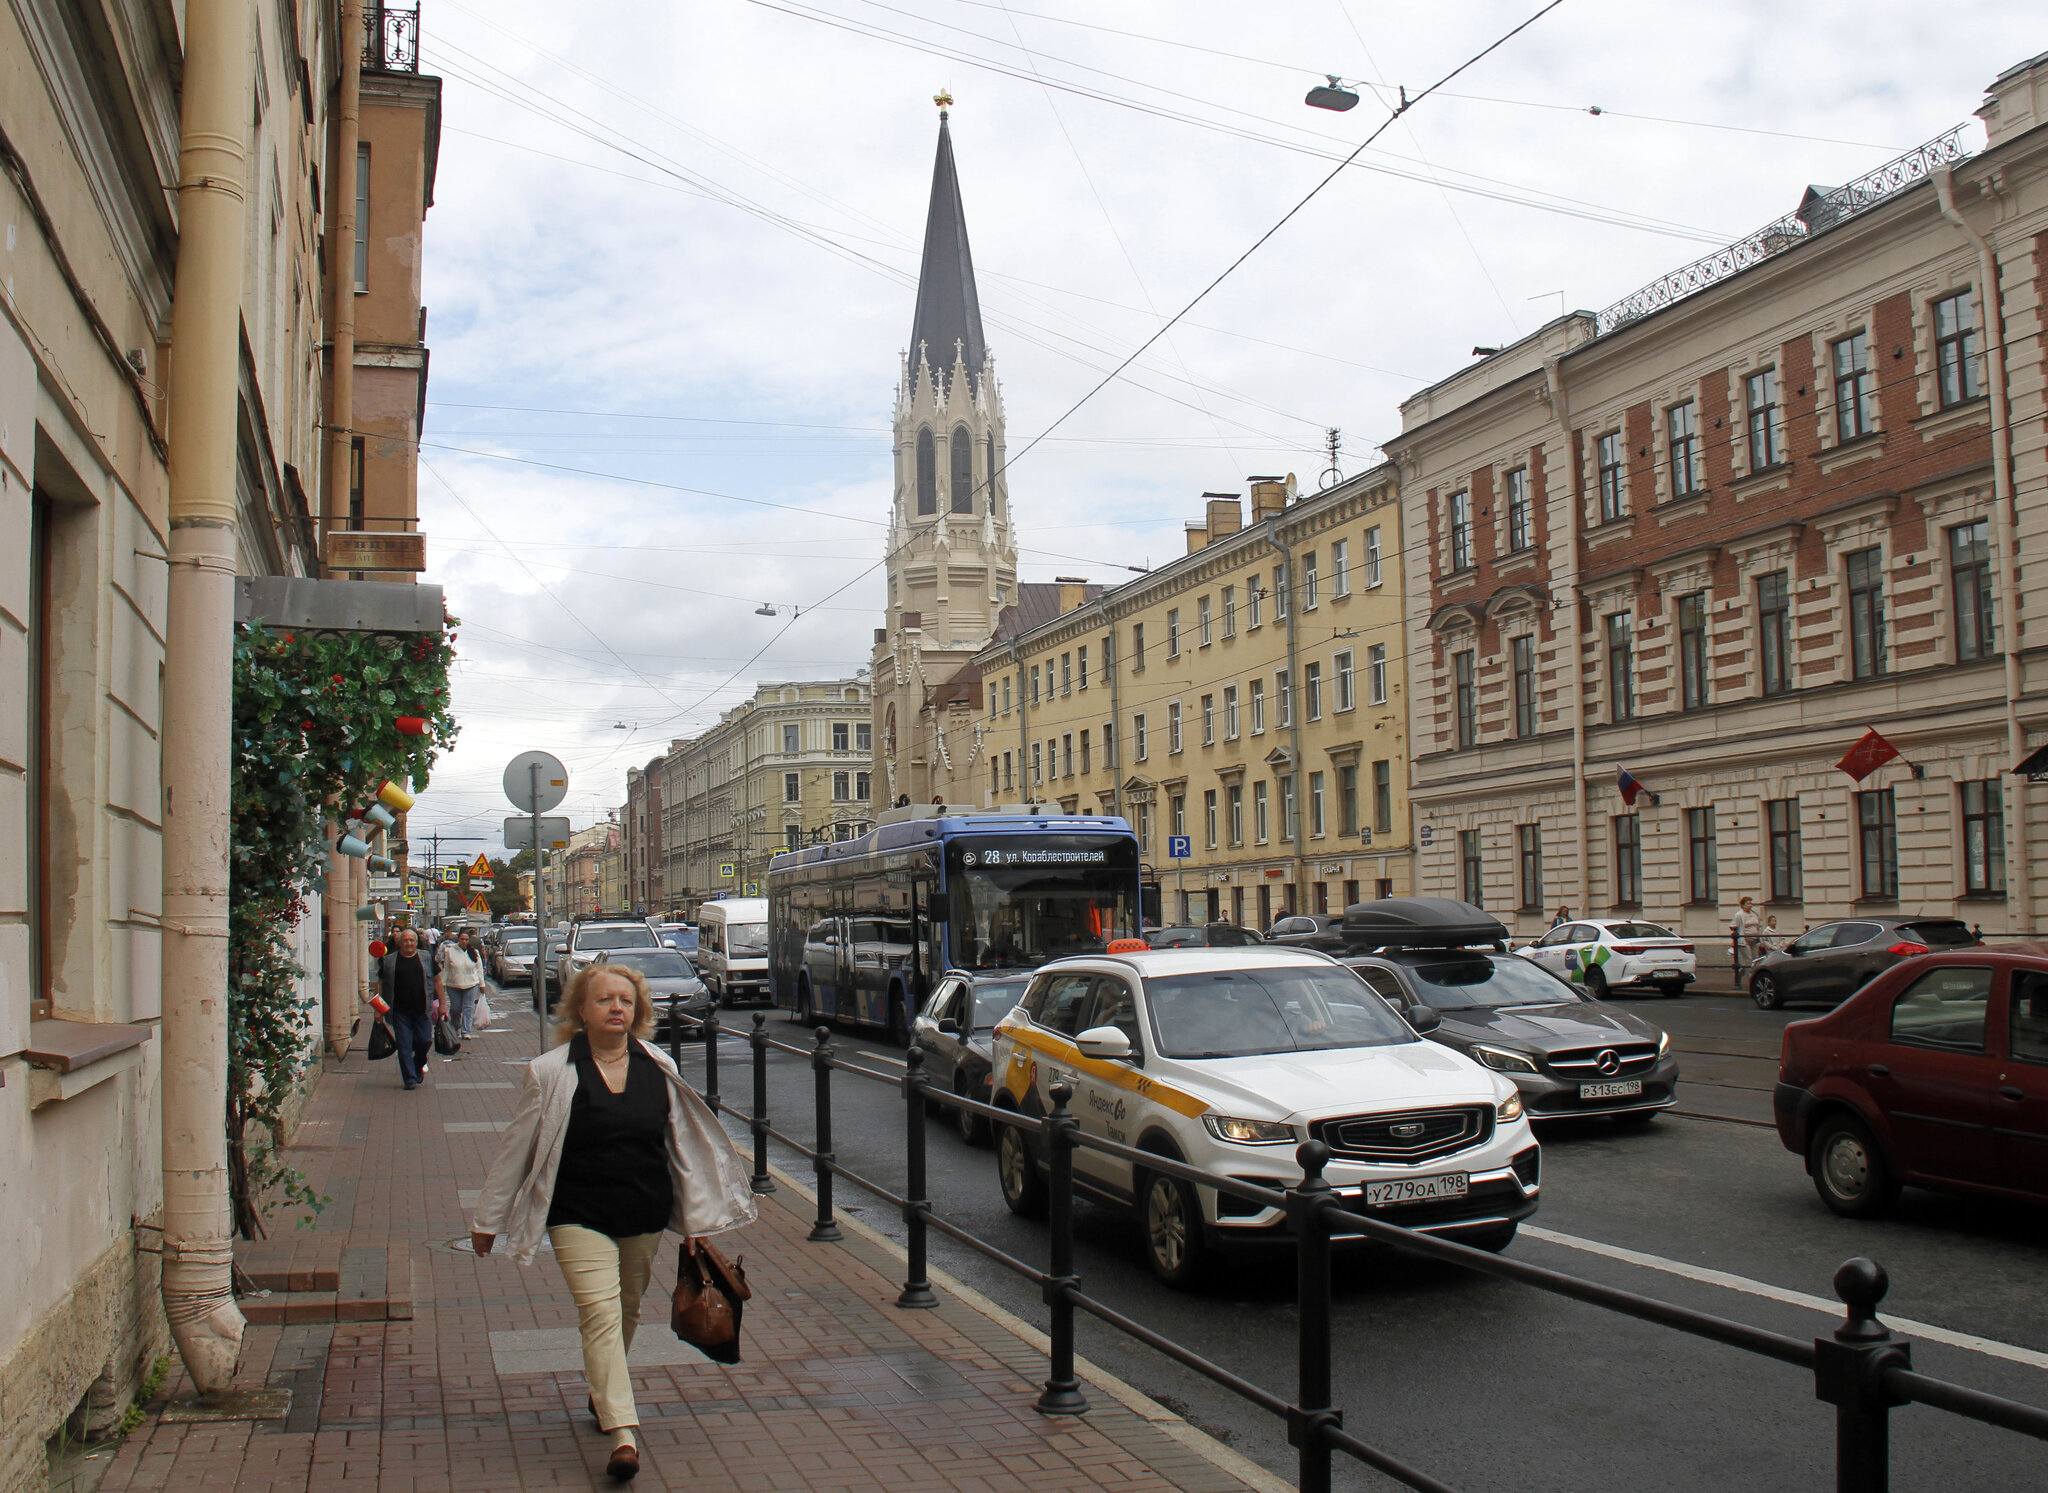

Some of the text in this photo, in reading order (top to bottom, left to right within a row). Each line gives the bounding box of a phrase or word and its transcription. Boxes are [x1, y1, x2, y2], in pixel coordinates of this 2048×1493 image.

[984, 850, 1105, 864] 28 ул. Кораблестроителей
[1583, 1081, 1640, 1097] Р313ЕС 198
[1089, 1089, 1126, 1121] Яндекс Go
[1105, 1120, 1127, 1145] Такси
[1372, 1181, 1437, 1202] У279ОА
[1440, 1175, 1463, 1190] 198
